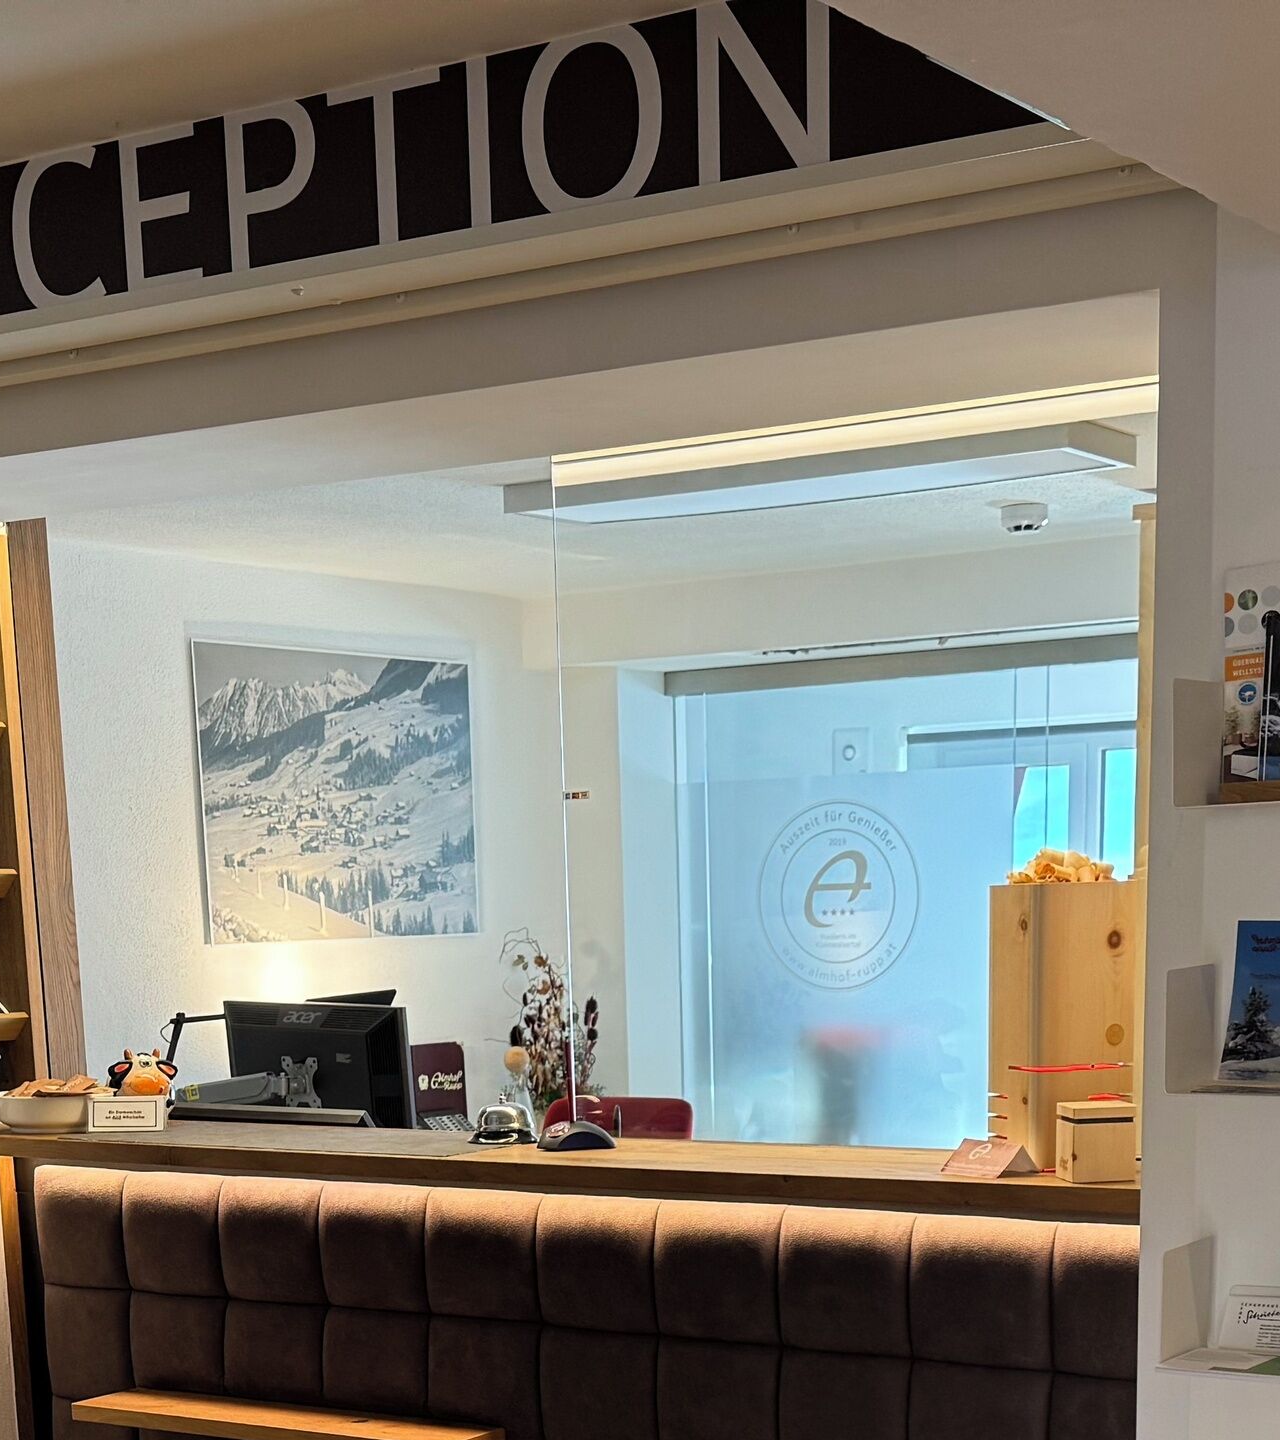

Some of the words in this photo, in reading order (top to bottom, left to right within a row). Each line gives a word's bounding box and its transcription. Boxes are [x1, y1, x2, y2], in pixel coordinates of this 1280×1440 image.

[780, 815, 821, 855] Auszeit
[825, 810, 842, 824] für
[848, 811, 898, 853] Genießer
[283, 1010, 322, 1024] acer
